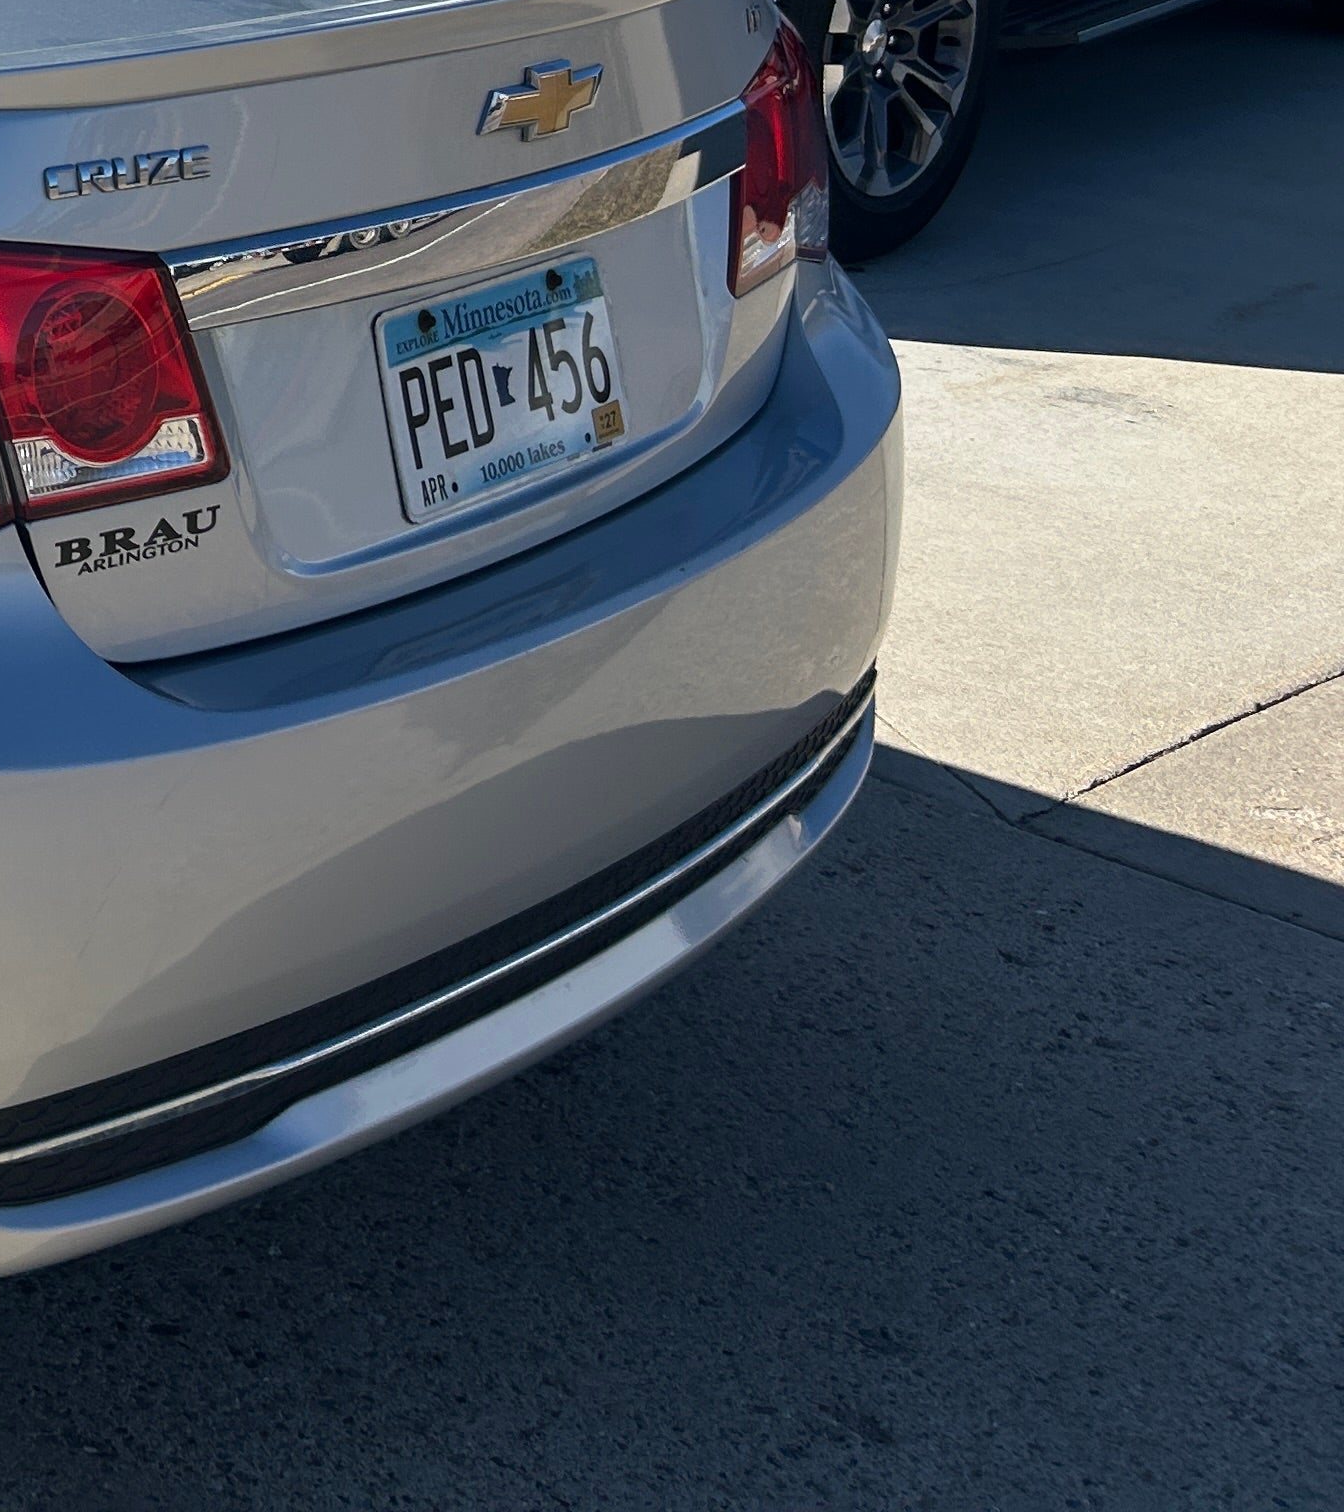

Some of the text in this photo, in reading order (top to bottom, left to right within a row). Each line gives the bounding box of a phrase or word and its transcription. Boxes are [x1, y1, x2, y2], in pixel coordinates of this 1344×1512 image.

[44, 144, 211, 200] CRUZE
[396, 329, 440, 355] EXPLORE
[399, 311, 611, 470] PED 456
[480, 439, 566, 484] 10,000 lakes
[421, 473, 449, 508] APR
[54, 504, 221, 568] BRAU
[77, 535, 200, 576] ARLINGTON
